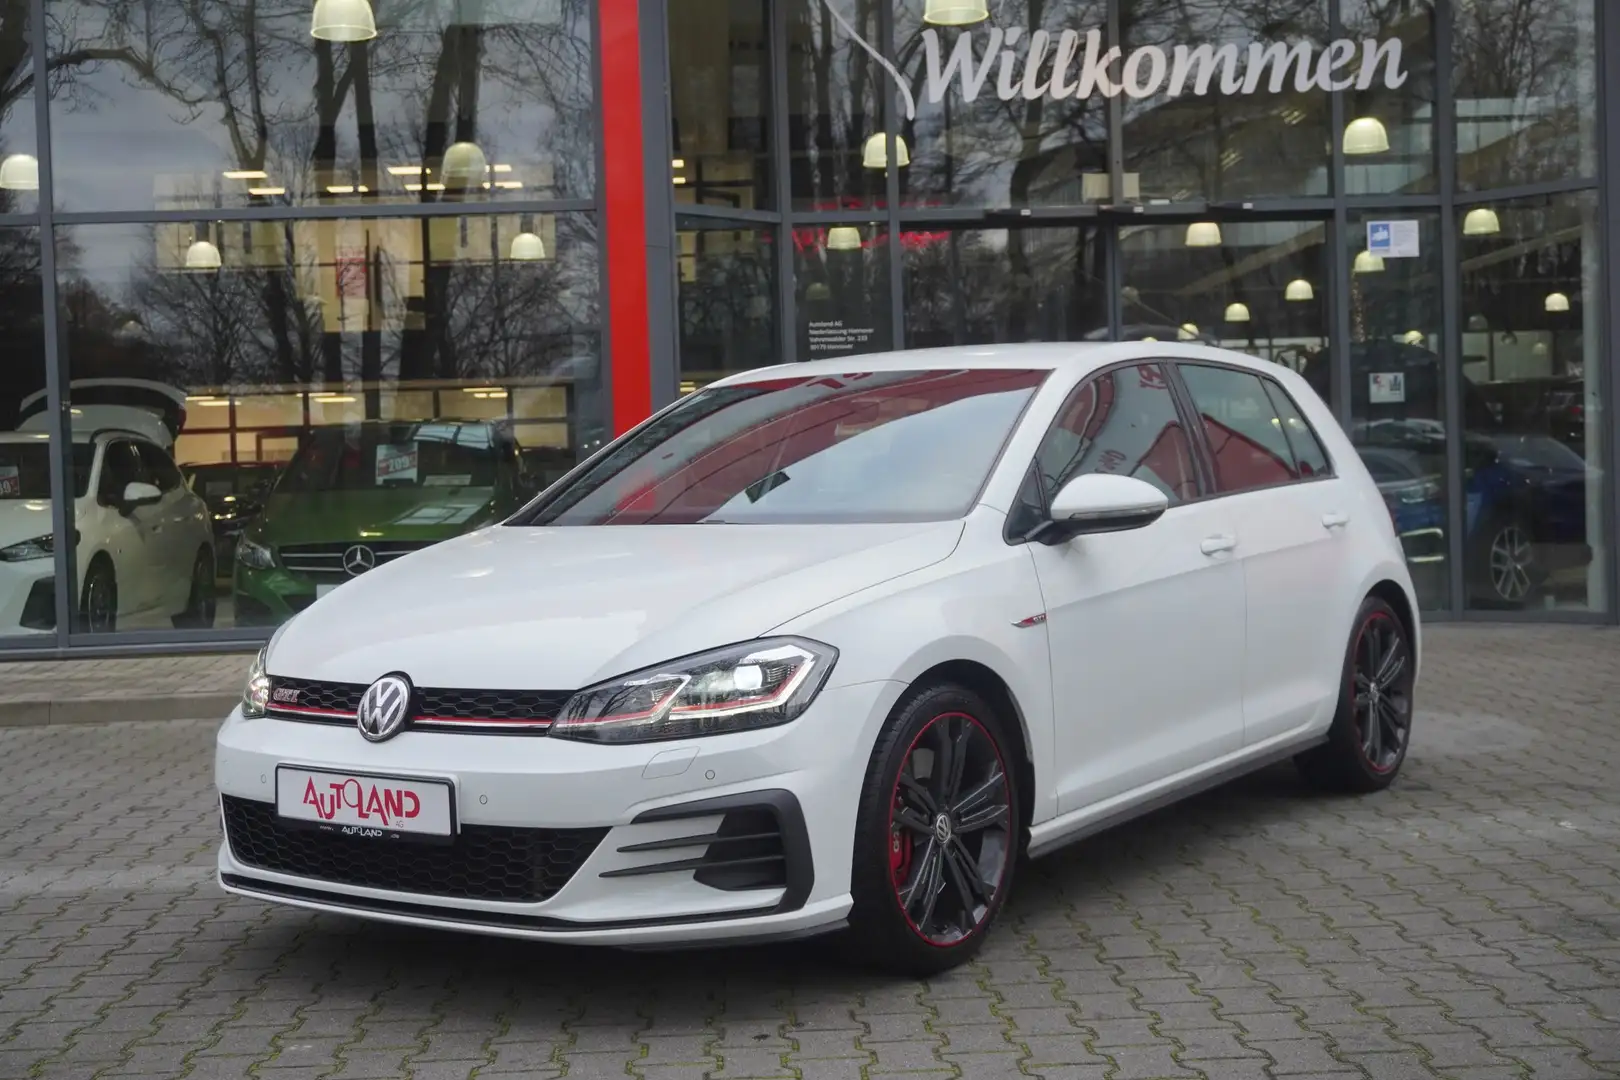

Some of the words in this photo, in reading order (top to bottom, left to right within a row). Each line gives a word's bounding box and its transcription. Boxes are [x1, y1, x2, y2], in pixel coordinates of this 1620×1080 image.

[921, 28, 1407, 104] Willkommen
[273, 688, 300, 702] GTI
[303, 776, 420, 826] AUTOLAND
[341, 826, 383, 837] AUTOLAND
